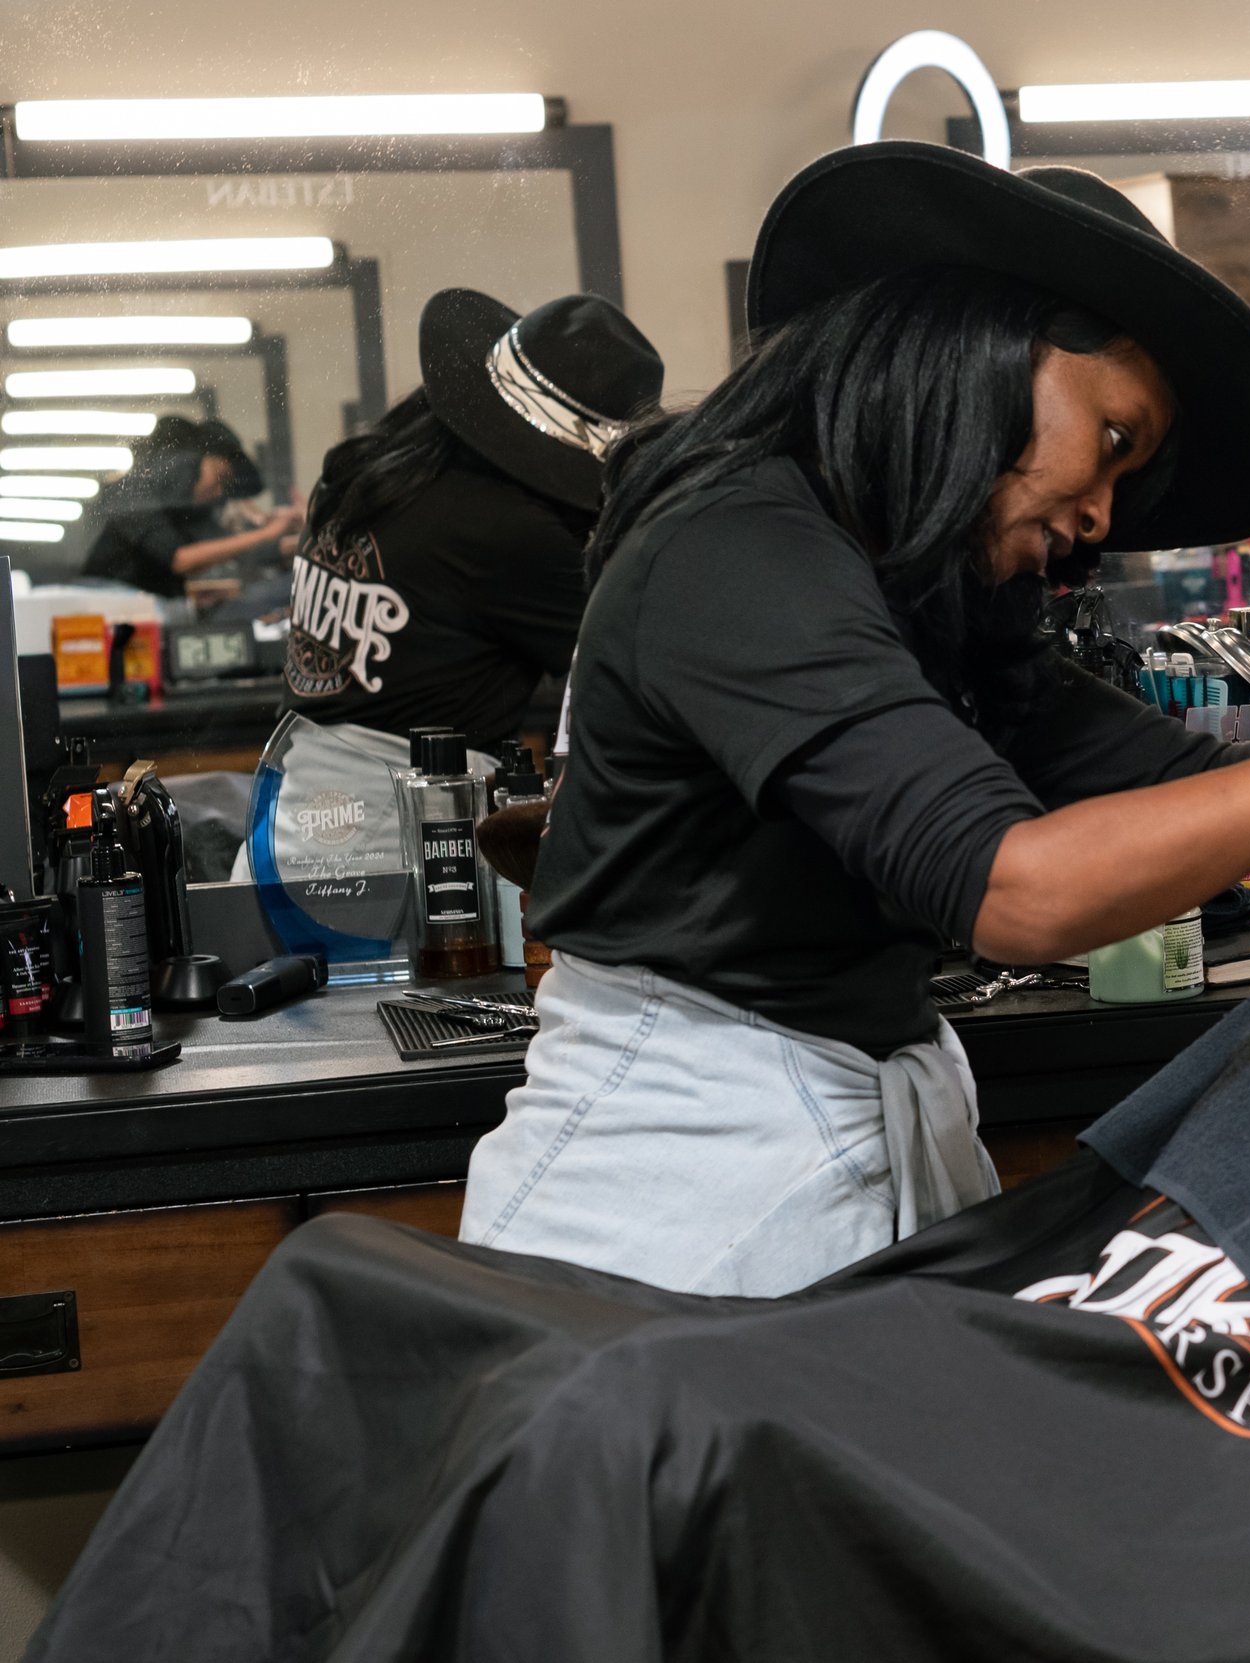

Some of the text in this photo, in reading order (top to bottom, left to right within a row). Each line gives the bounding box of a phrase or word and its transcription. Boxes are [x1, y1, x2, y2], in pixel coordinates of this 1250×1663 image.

[297, 800, 365, 842] PRIME
[424, 839, 473, 860] BARBER
[305, 883, 352, 898] Tiffany
